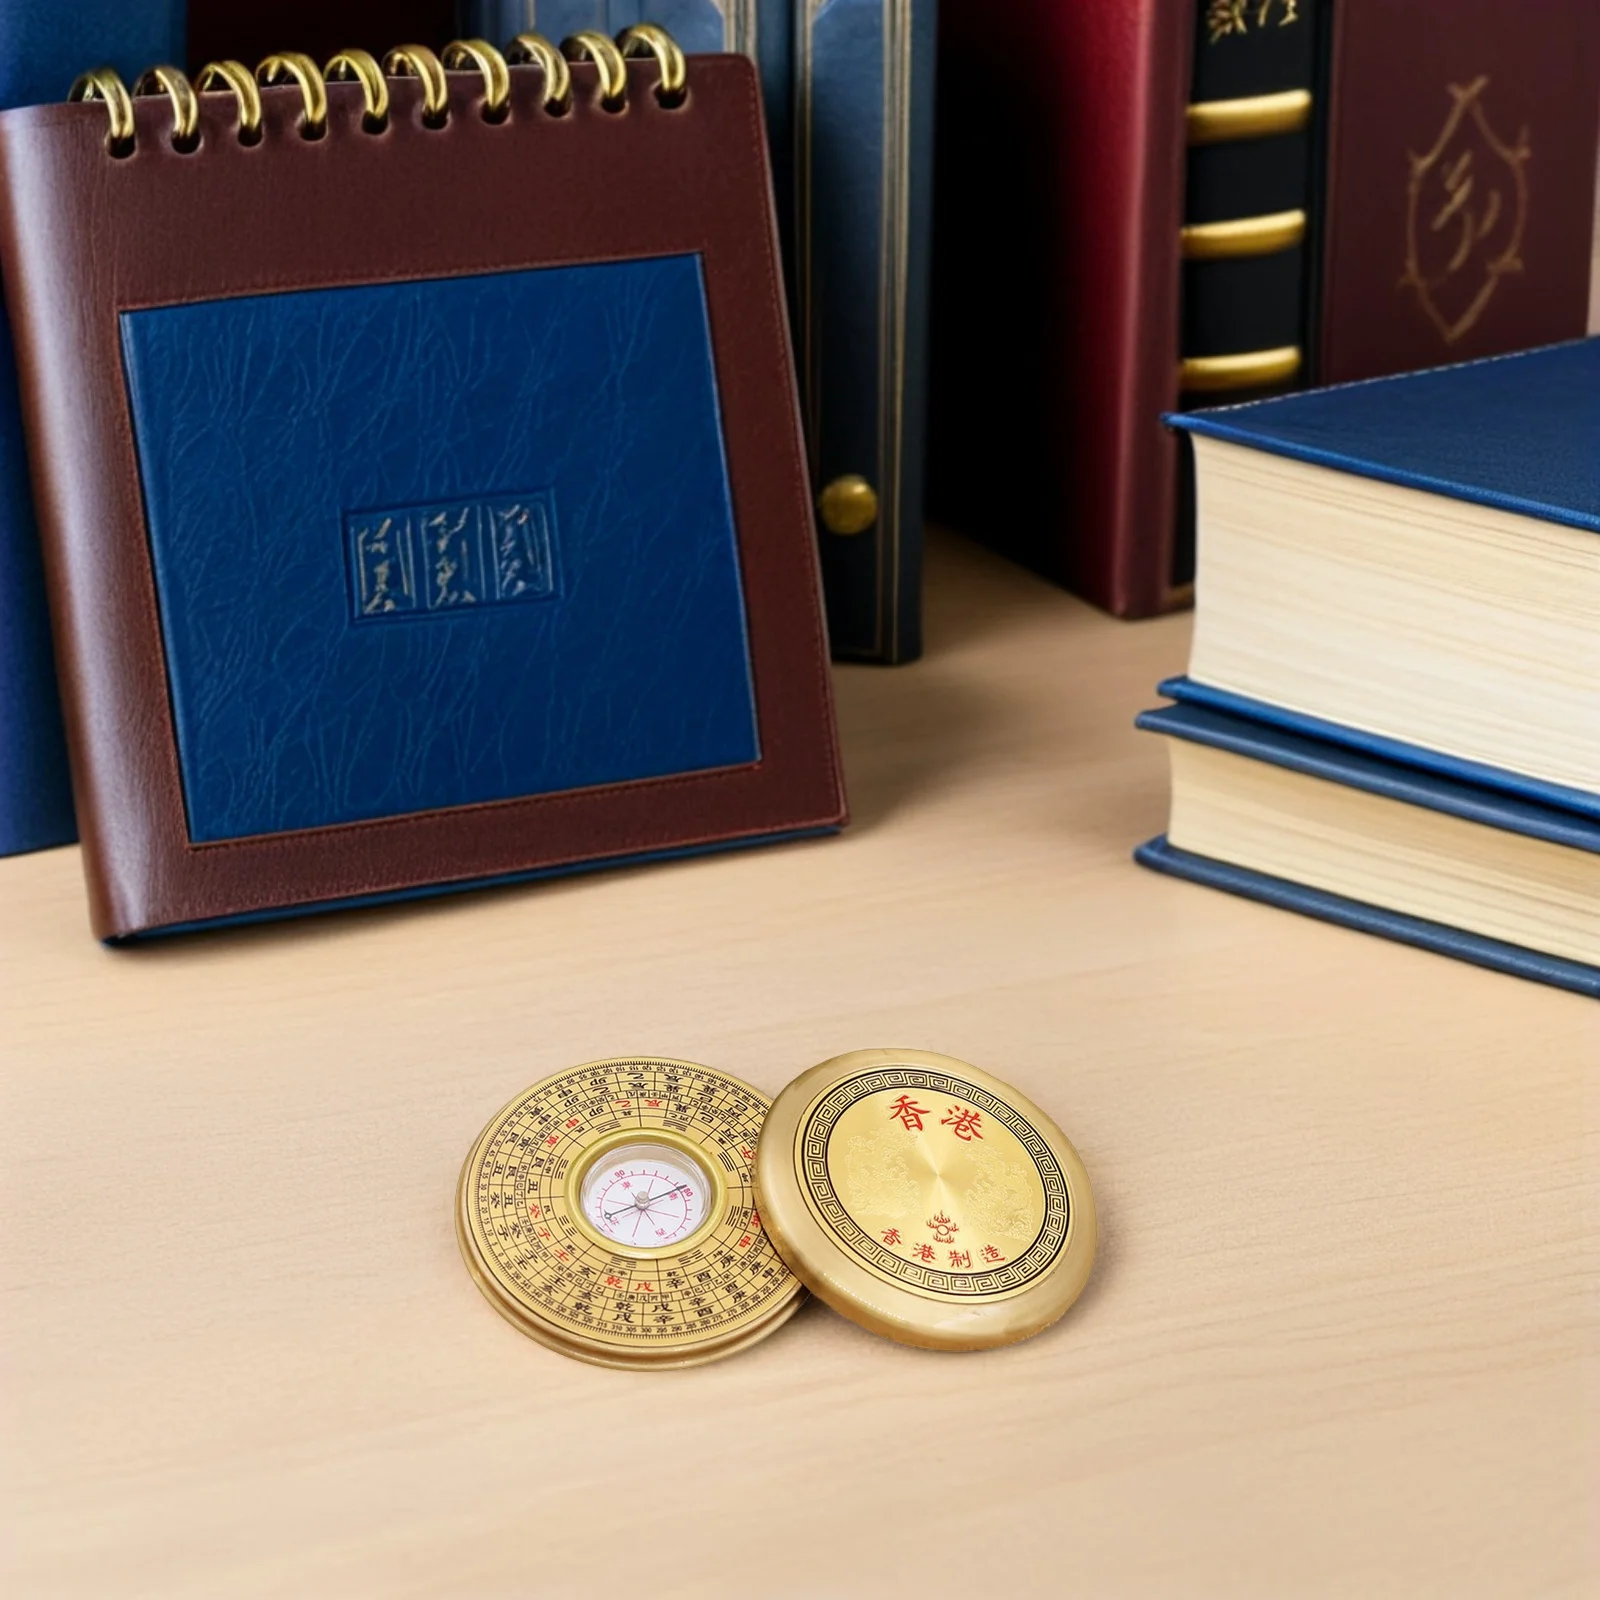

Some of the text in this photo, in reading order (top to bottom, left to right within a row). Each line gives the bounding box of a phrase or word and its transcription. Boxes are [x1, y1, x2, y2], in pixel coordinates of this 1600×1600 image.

[890, 1094, 984, 1141] 香港
[505, 1132, 519, 1144] 艮
[492, 1161, 504, 1176] 丑
[614, 1170, 625, 1178] 90
[528, 1179, 538, 1194] 丑
[480, 1195, 487, 1203] 25
[504, 1192, 513, 1209] 丑
[497, 1224, 508, 1241] 子
[538, 1226, 551, 1241] 子
[881, 1227, 1005, 1268] 香港制造
[525, 1248, 538, 1263] 子
[713, 1315, 723, 1323] 275
[727, 1308, 737, 1317] 270
[611, 1322, 623, 1331] 310
